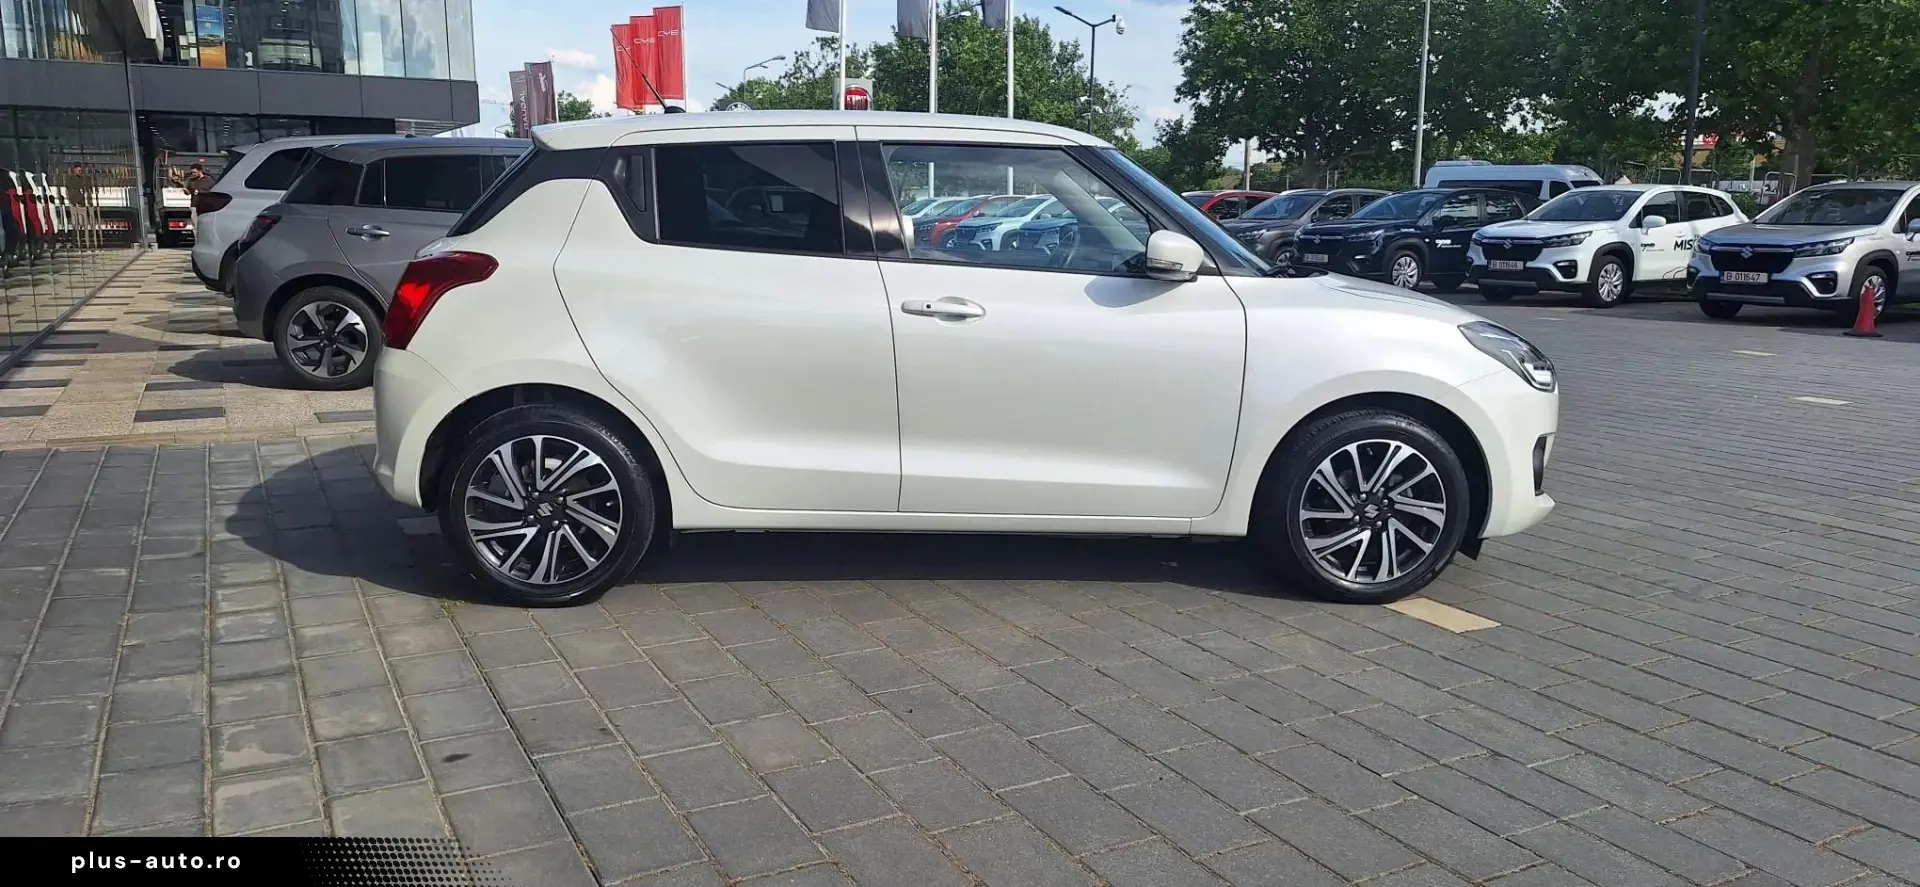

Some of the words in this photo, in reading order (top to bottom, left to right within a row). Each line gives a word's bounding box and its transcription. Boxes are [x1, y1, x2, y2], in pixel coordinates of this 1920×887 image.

[1673, 239, 1695, 251] MIS
[1726, 272, 1733, 281] B
[1735, 272, 1761, 282] 011647
